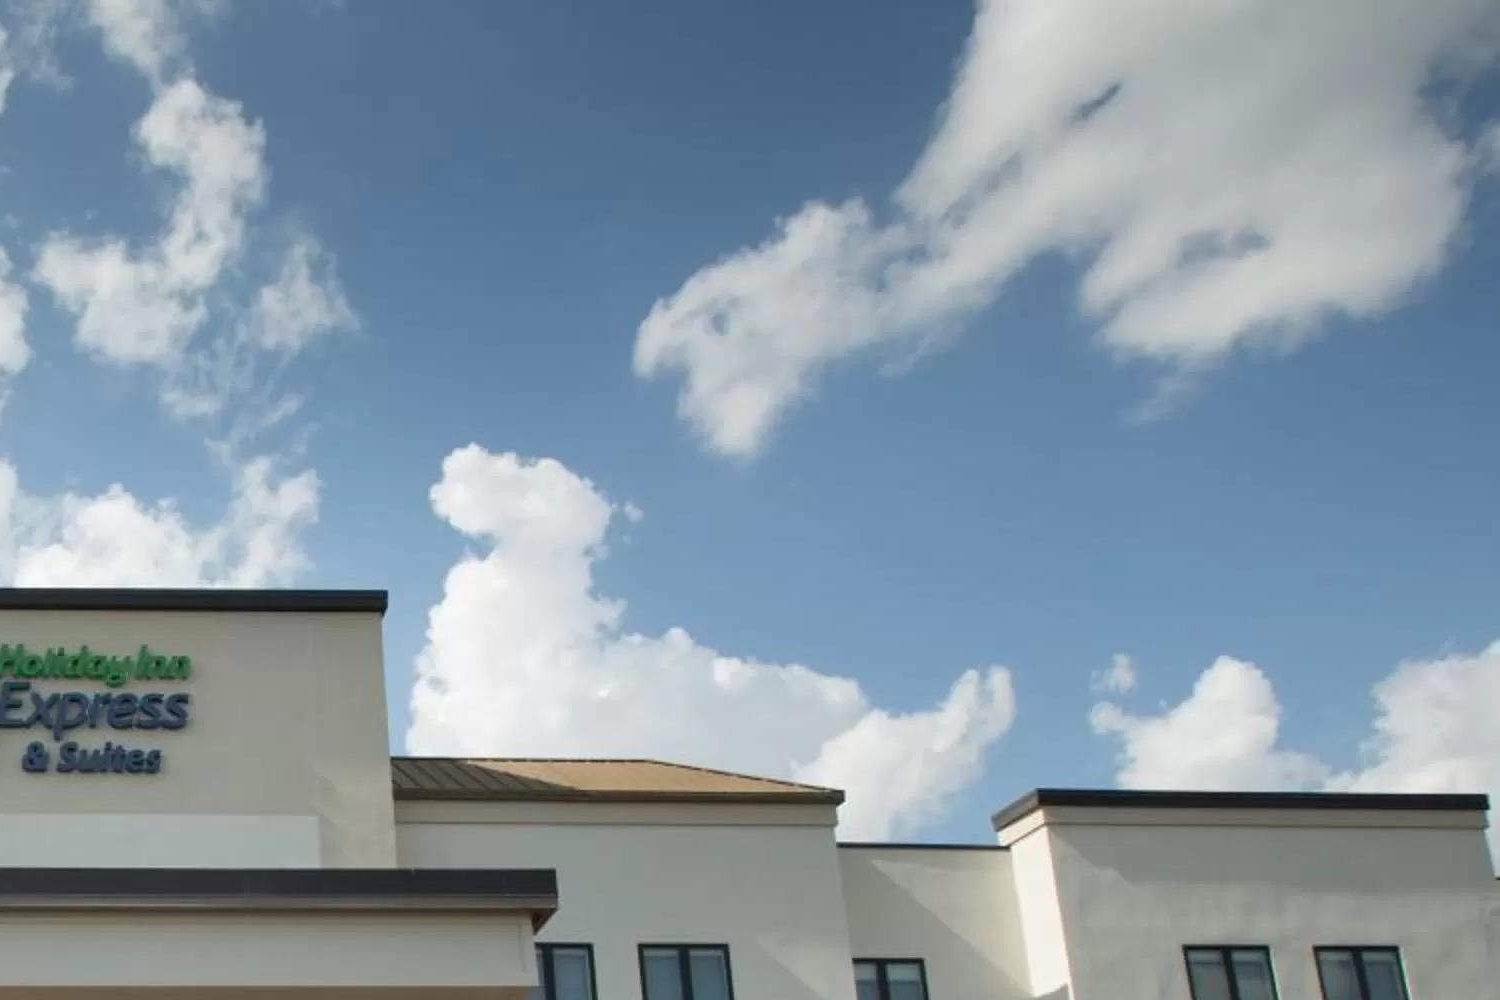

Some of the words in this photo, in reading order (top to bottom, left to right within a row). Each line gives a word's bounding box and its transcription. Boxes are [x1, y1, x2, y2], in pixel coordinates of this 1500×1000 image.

[135, 645, 192, 680] Inn
[21, 741, 48, 773] &
[56, 742, 162, 773] Suites
